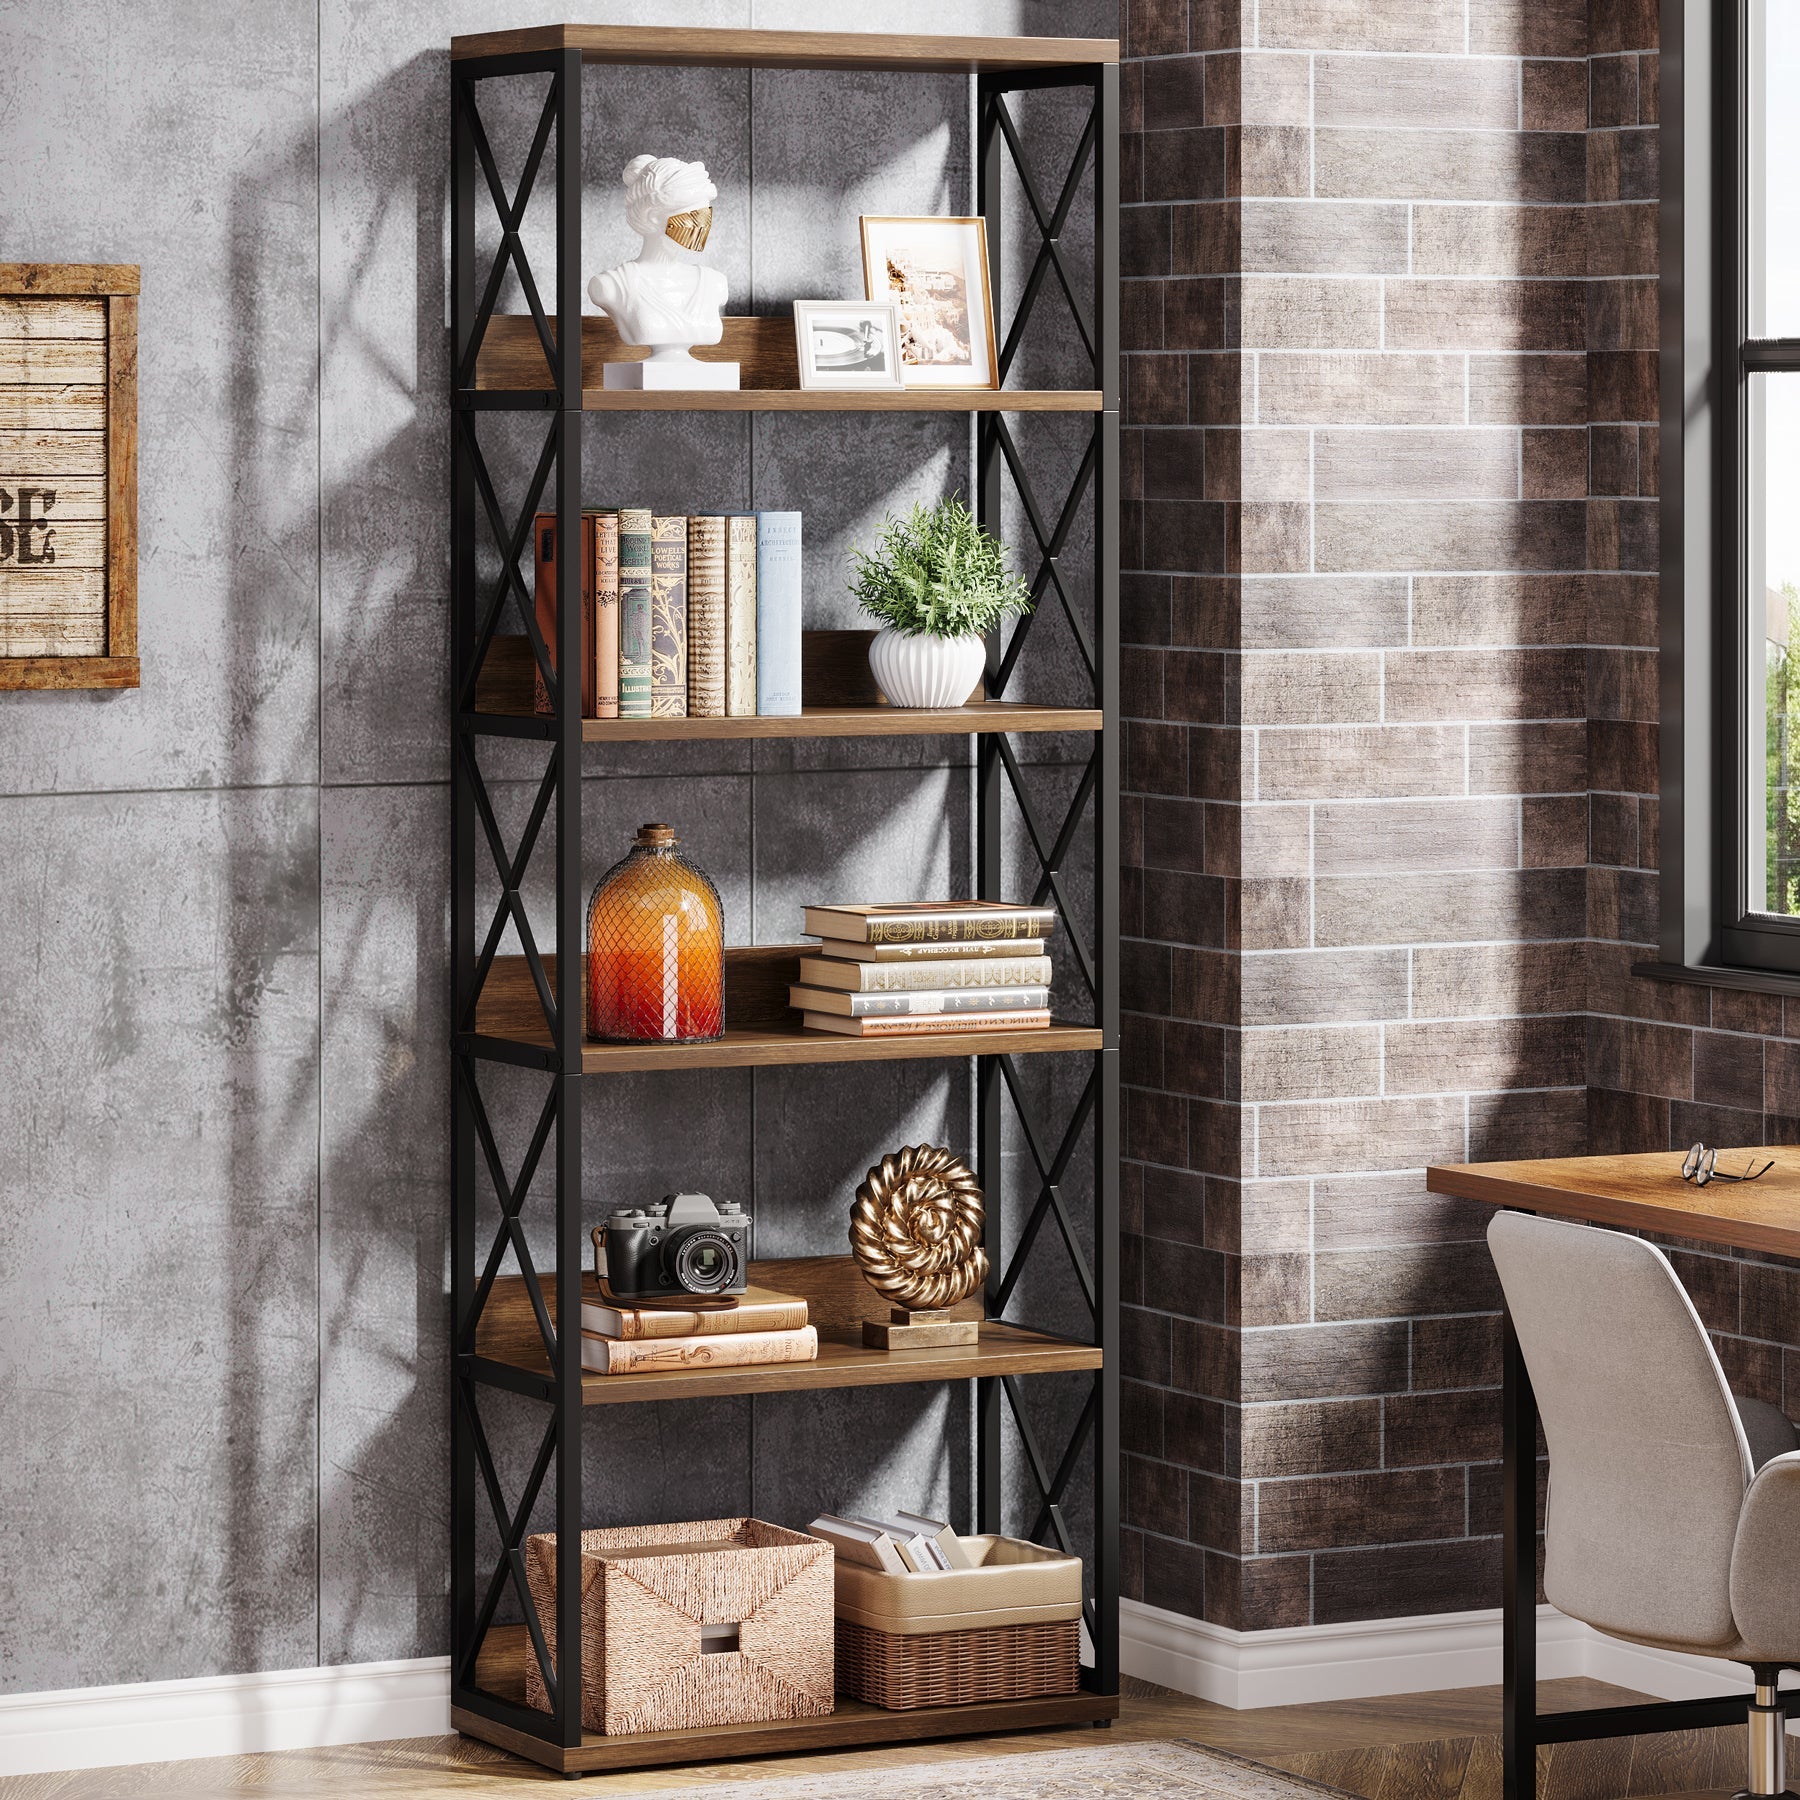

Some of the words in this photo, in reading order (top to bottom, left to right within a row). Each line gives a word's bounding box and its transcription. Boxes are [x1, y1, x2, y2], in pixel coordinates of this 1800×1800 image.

[600, 546, 616, 554] LIVE
[651, 547, 685, 555] LOWELL'S
[654, 554, 683, 562] POETICAL
[656, 561, 680, 570] WORKS
